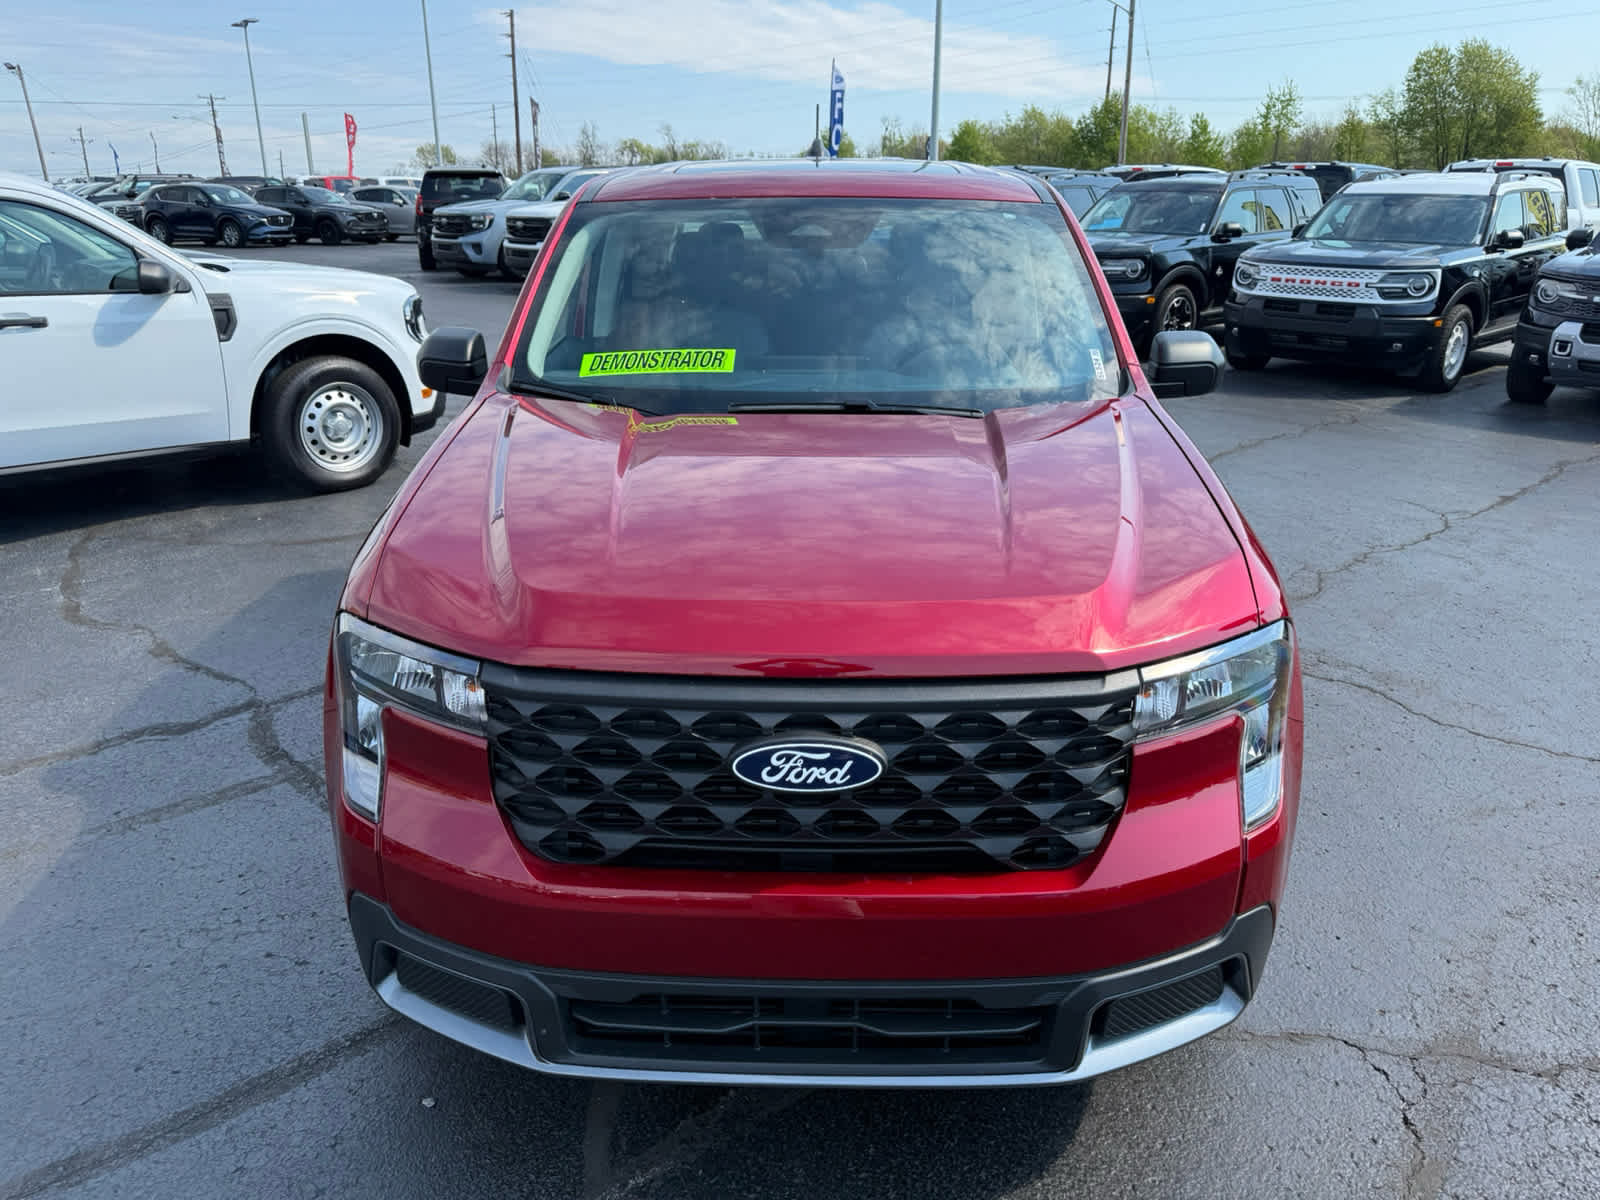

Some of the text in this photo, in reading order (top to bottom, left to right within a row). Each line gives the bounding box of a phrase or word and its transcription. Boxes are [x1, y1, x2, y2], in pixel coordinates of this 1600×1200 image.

[1270, 276, 1361, 288] BRONCO
[589, 350, 726, 372] DEMONSTRATOR
[760, 750, 854, 785] Ford
